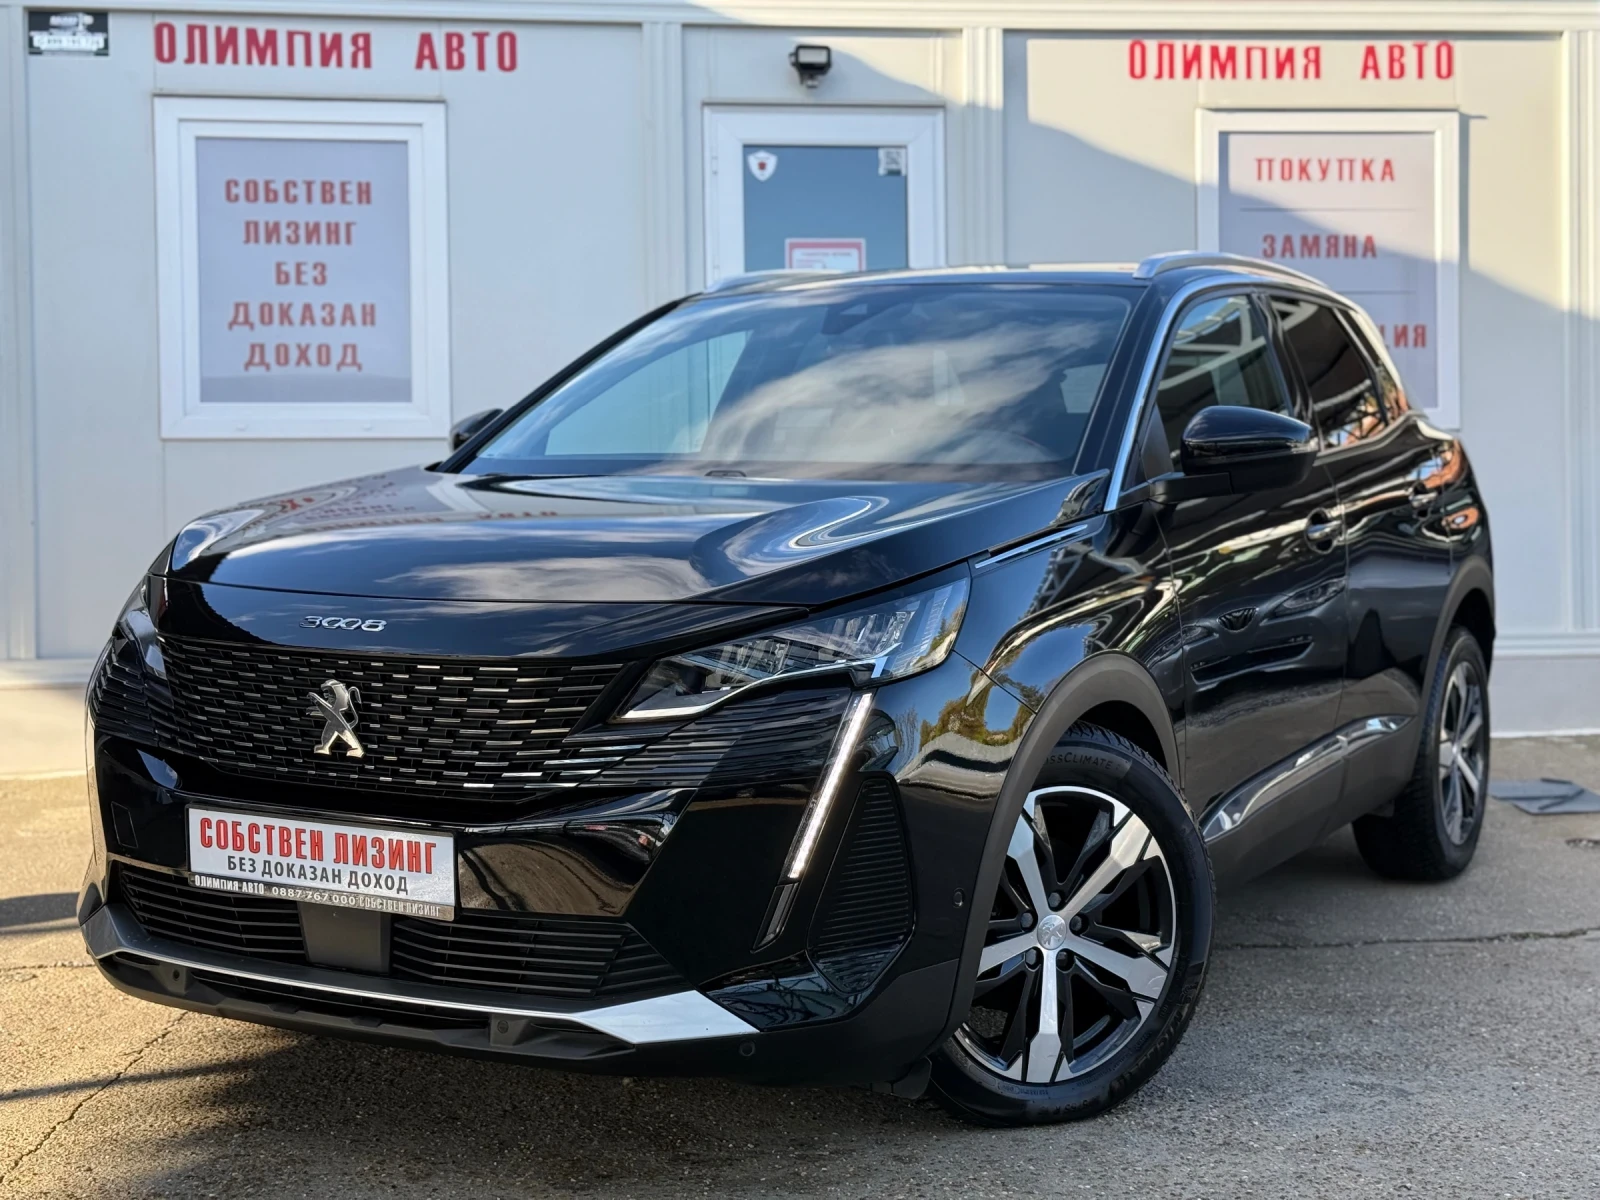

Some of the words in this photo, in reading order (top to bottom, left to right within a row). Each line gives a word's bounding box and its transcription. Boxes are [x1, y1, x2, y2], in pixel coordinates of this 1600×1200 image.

[154, 22, 372, 69] ОЛИМПИЯ
[415, 31, 518, 72] АВТО
[1128, 40, 1322, 80] ОЛИМПИЯ
[1360, 40, 1454, 80] АВТО
[1256, 157, 1395, 182] ПОКУПКА
[225, 179, 372, 205] СОБСТВЕН
[243, 220, 357, 246] ЛИЗИНГ
[1262, 235, 1377, 259] ЗАМЯНА
[275, 262, 328, 287] БЕЗ
[228, 302, 377, 331] ДОКАЗАН
[244, 343, 363, 372] ДОХОД
[300, 615, 387, 632] 3008
[200, 817, 324, 862] СОБСТВЕН
[333, 832, 437, 875] ЛИЗИНГ
[227, 855, 257, 873] БЕЗ
[261, 860, 342, 884] ДОКАЗАН
[347, 870, 409, 895] ДОХОД
[194, 874, 239, 892] ОЛИМПИЯ
[242, 881, 265, 895] АВТО
[271, 886, 302, 899] 0887
[305, 891, 329, 902] 767
[332, 894, 356, 906] 000
[359, 895, 404, 913] СОБСТВЕН
[406, 901, 441, 917] ЛИЗИНГ
